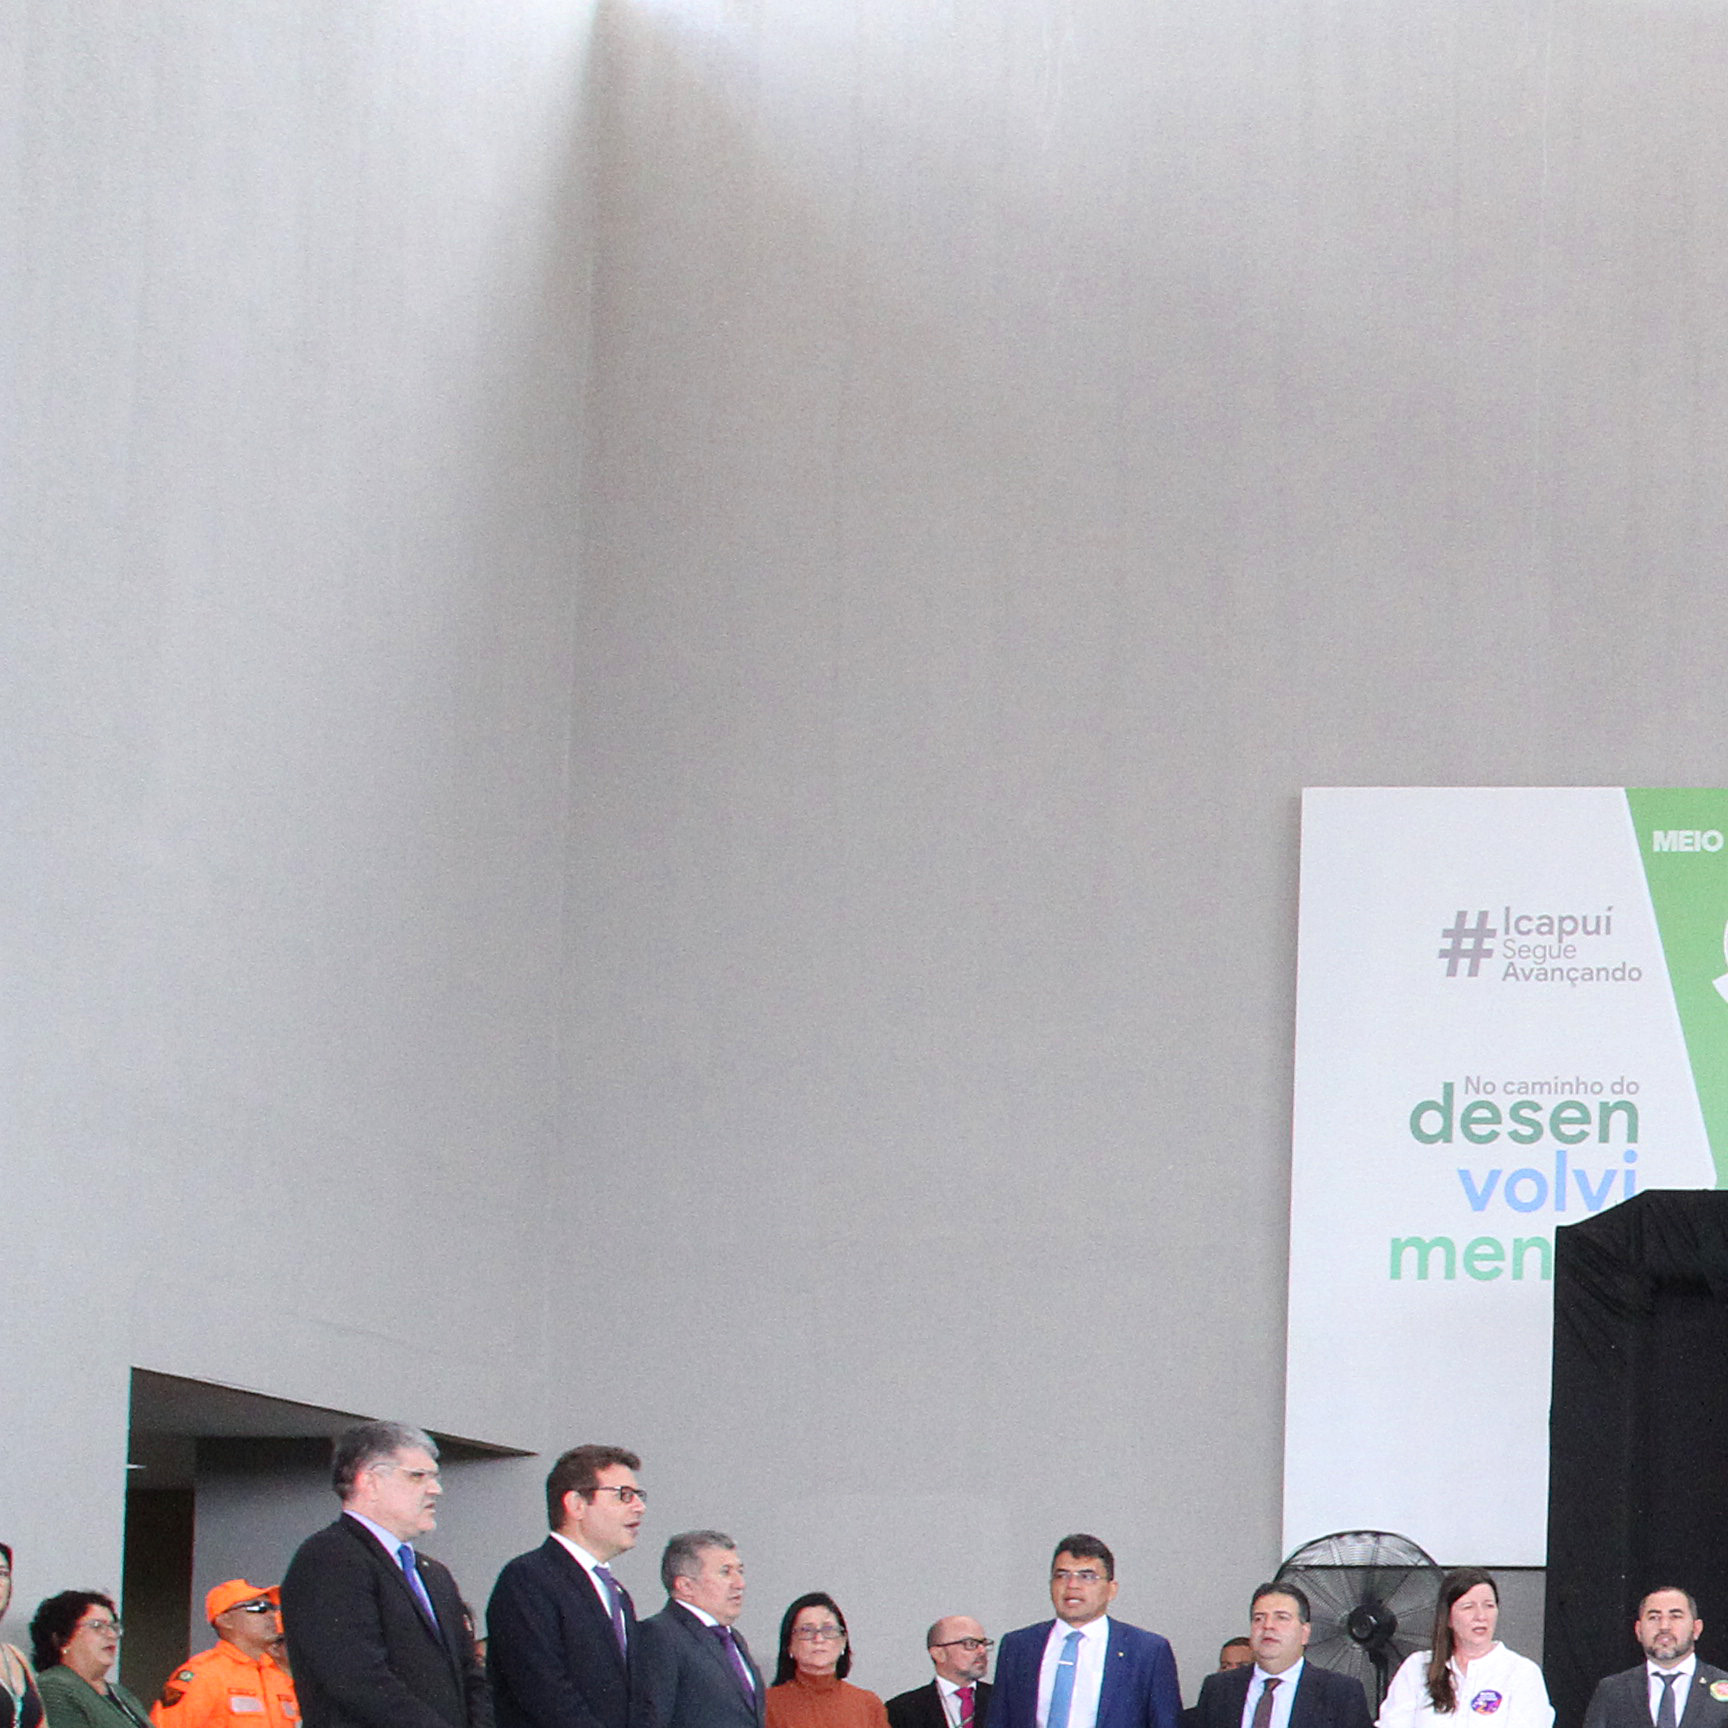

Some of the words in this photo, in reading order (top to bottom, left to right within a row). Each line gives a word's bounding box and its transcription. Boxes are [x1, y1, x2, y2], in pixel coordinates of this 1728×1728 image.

[1653, 829, 1725, 853] MEIO
[1502, 939, 1577, 965] Segue
[1502, 962, 1643, 987] Avançando
[1464, 1075, 1497, 1096] No
[1503, 1076, 1605, 1096] caminho
[1611, 1076, 1640, 1096] do
[1409, 1081, 1639, 1144] desen
[1457, 1150, 1638, 1213] volvi
[1389, 1236, 1552, 1281] men
